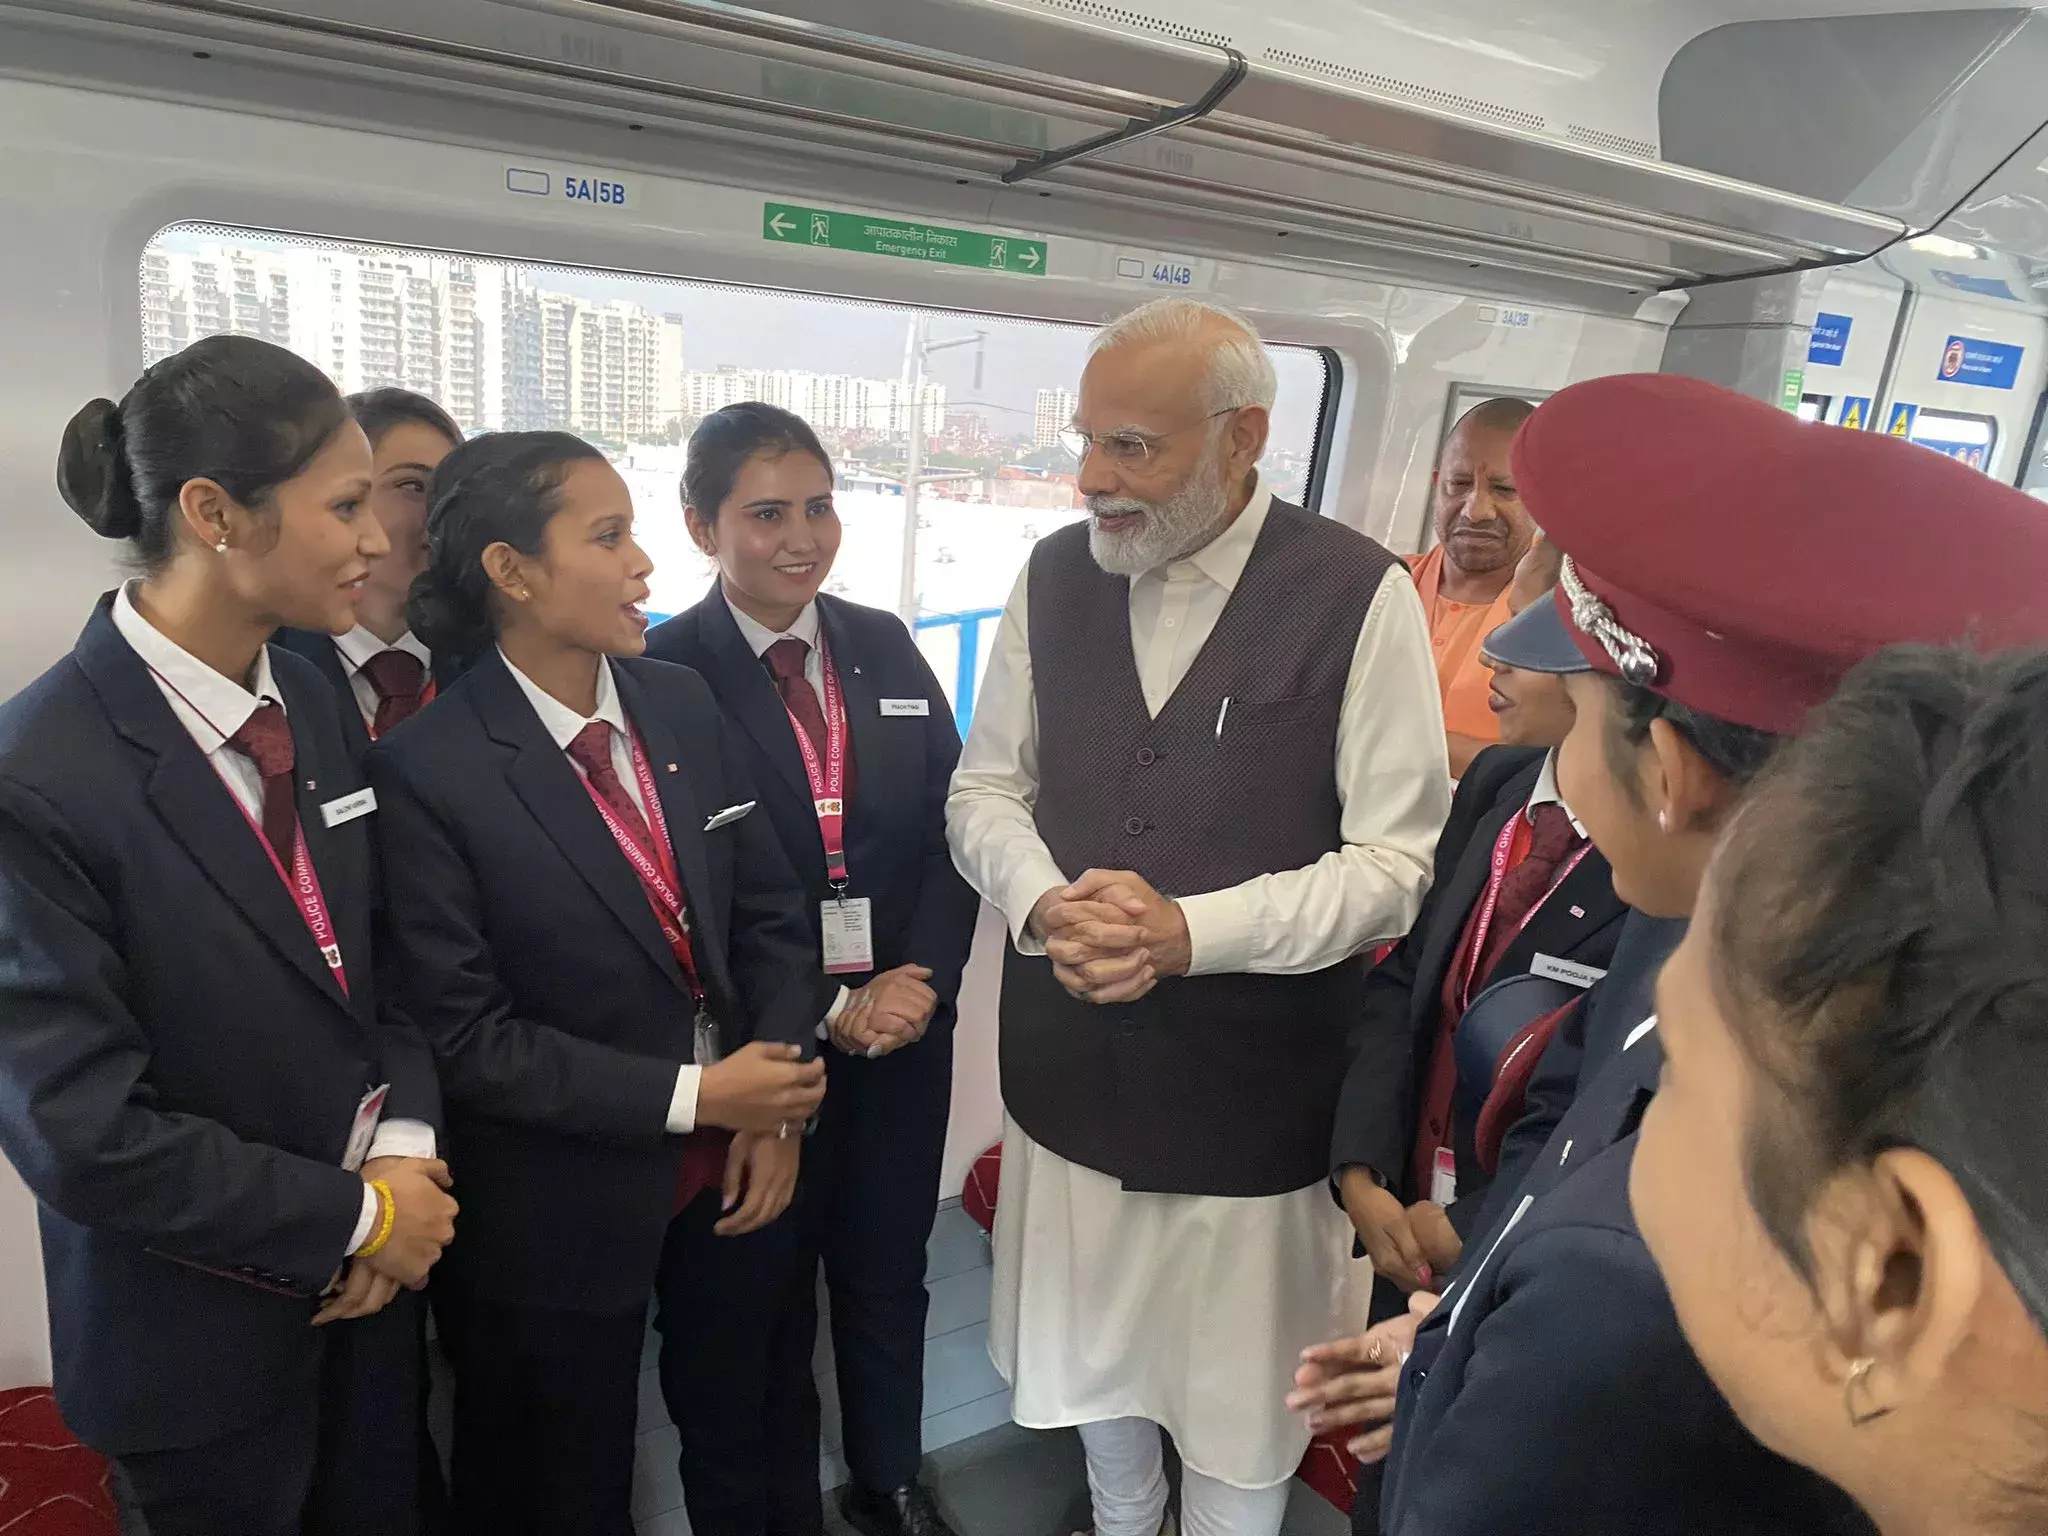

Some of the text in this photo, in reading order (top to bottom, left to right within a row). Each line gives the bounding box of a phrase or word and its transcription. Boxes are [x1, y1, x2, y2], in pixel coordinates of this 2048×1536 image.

[863, 225, 958, 247] आपातकालीन निकास
[875, 240, 946, 259] Emergency Exit
[828, 684, 840, 759] COMMISSIONERATE
[808, 761, 823, 794] POLICE
[830, 761, 840, 792] POLICE
[1495, 851, 1506, 866] OF
[653, 875, 679, 907] POLICE
[304, 895, 328, 940] POLICE
